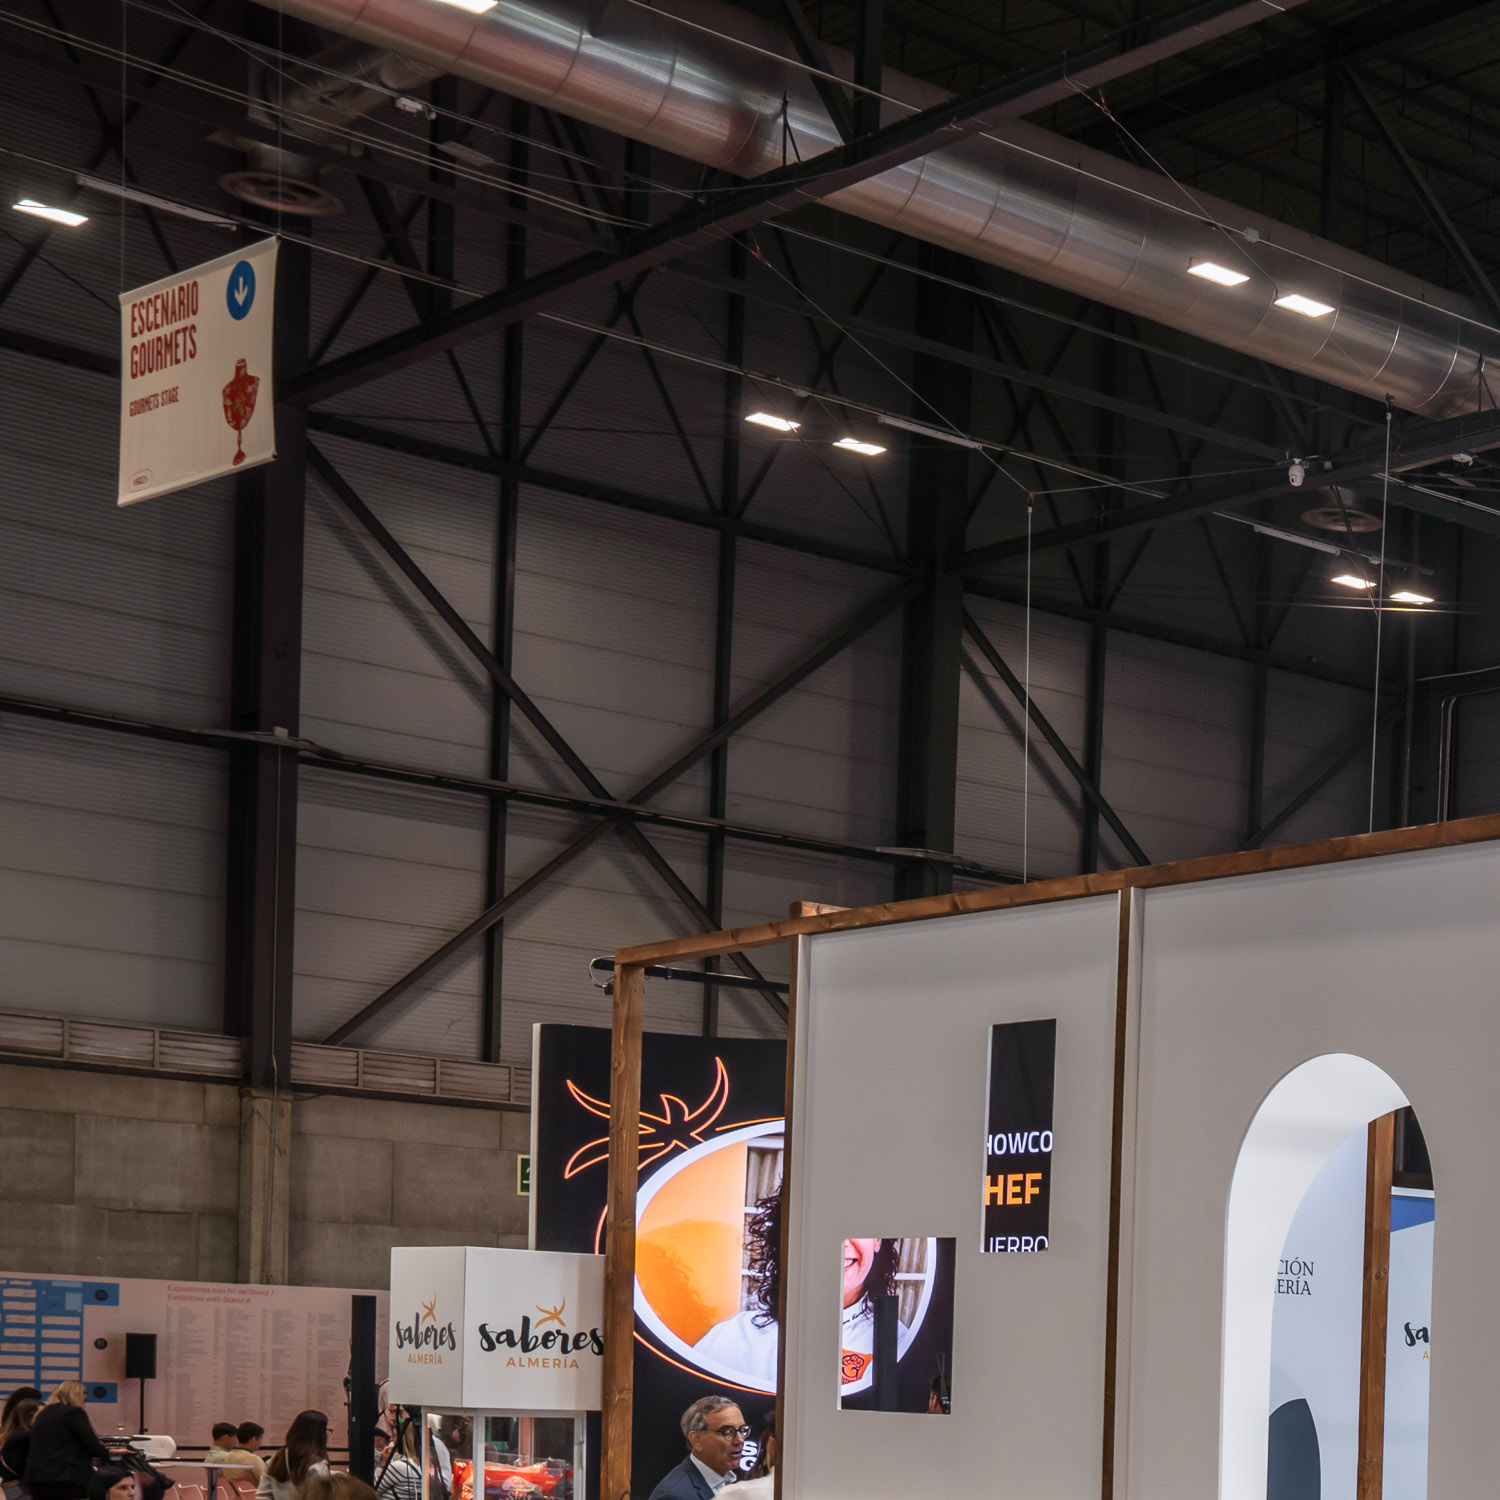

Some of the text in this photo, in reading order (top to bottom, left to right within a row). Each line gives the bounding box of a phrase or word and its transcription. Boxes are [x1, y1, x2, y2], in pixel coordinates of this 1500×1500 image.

[131, 280, 199, 339] ESCENARIO
[130, 324, 197, 380] GOURMETS
[129, 386, 180, 417] GOURMETS STAGE
[1275, 1276, 1312, 1296] ERÍA
[407, 1352, 443, 1365] ALMERÍA
[506, 1356, 579, 1369] ALMERÍA
